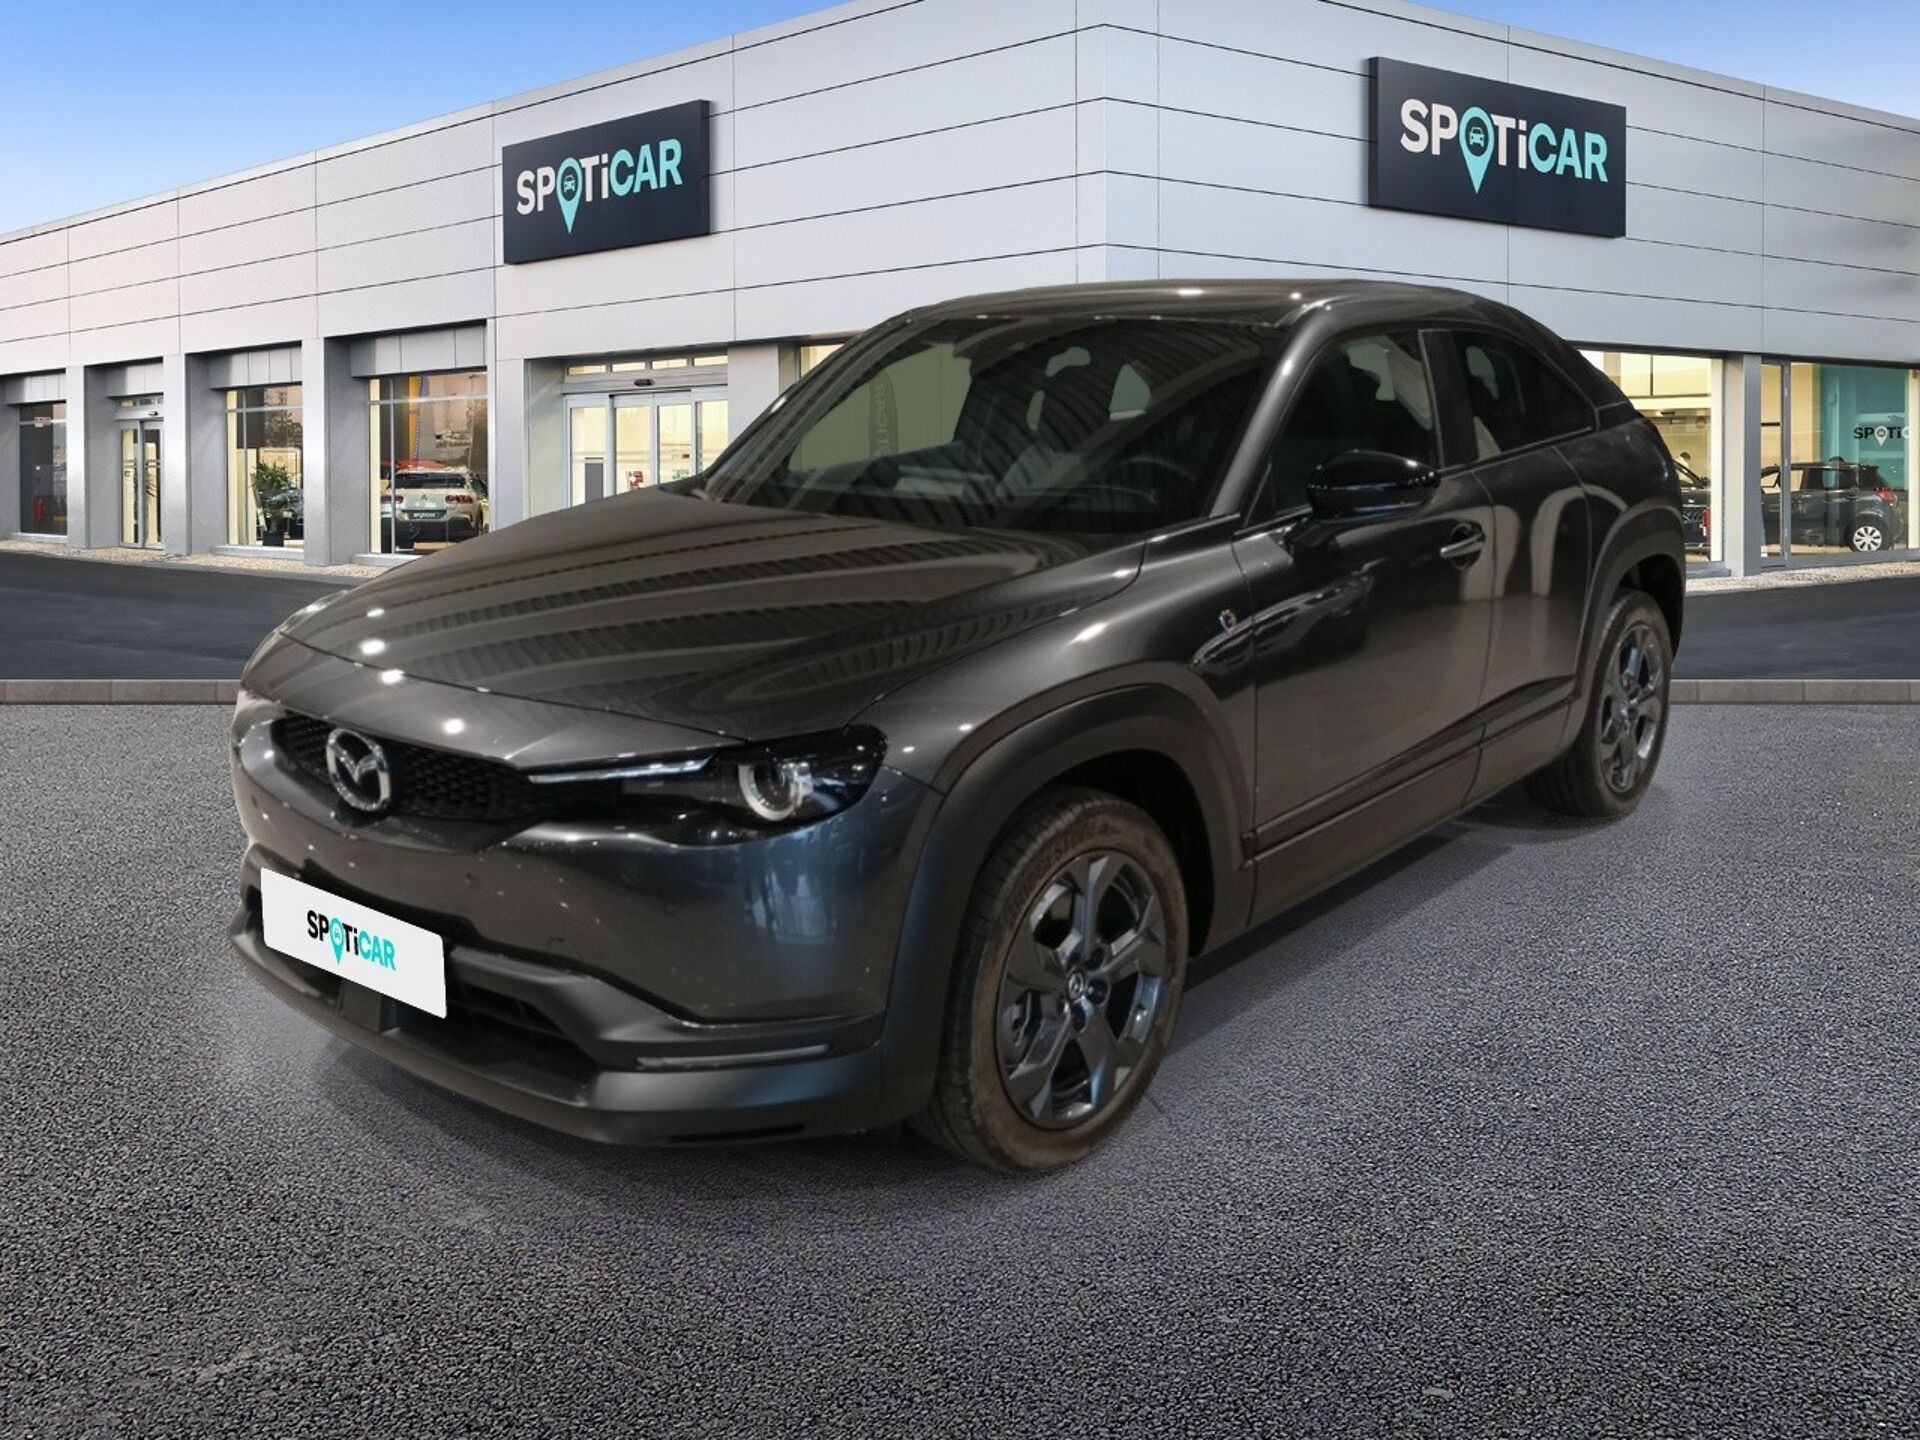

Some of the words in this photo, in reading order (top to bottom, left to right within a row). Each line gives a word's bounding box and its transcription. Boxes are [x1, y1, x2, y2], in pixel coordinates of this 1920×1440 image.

[516, 138, 684, 234] SPOTiCAR
[1400, 98, 1608, 194] SPOTiCAR
[306, 910, 397, 971] SPOTiCAR
